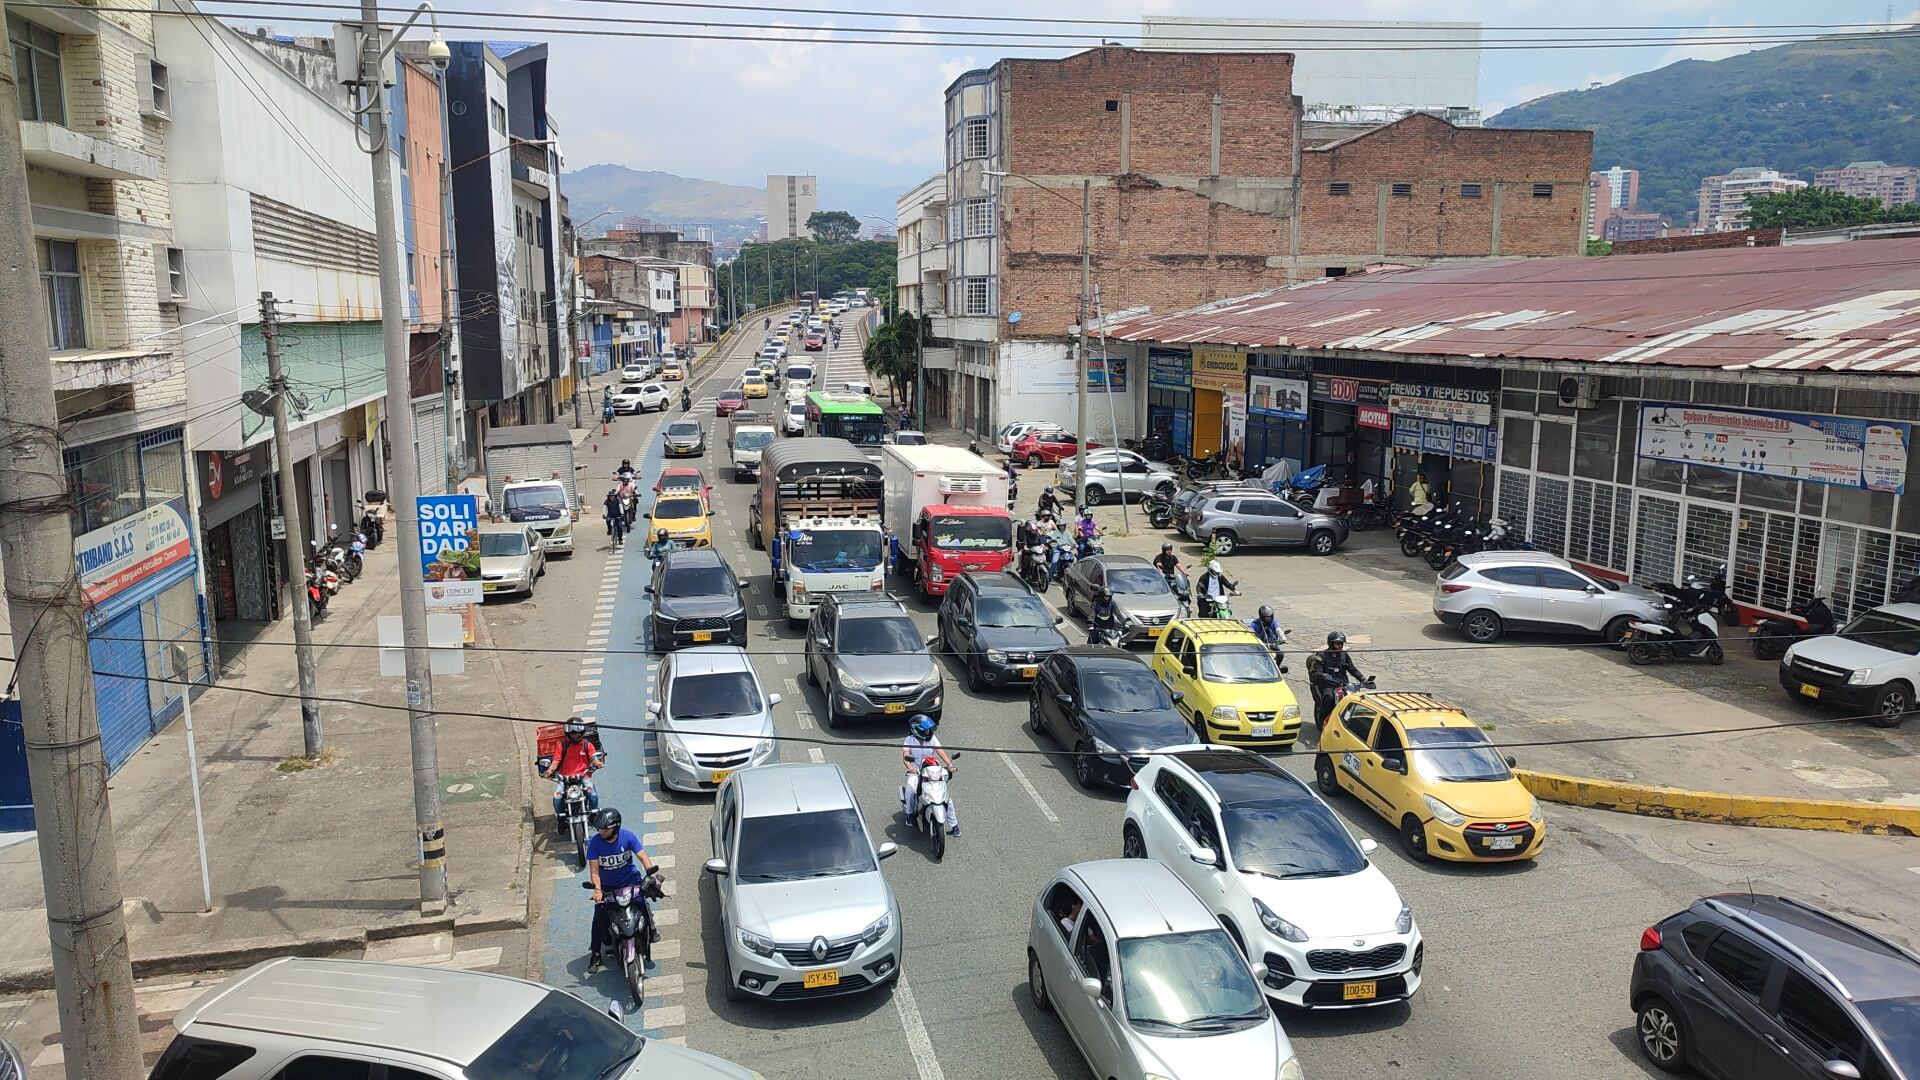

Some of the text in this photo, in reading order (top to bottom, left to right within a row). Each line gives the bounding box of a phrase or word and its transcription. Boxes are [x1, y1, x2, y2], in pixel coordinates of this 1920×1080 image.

[1331, 378, 1360, 402] EDDY
[1360, 385, 1378, 394] CUSTOM
[1390, 383, 1490, 403] FRENOS Y REPUESTOS
[1360, 410, 1388, 426] MOTUL
[420, 504, 470, 520] SOLI
[420, 520, 473, 537] DARI
[422, 538, 468, 554] DAD
[806, 971, 837, 984] JSY 451
[1360, 984, 1374, 994] 531
